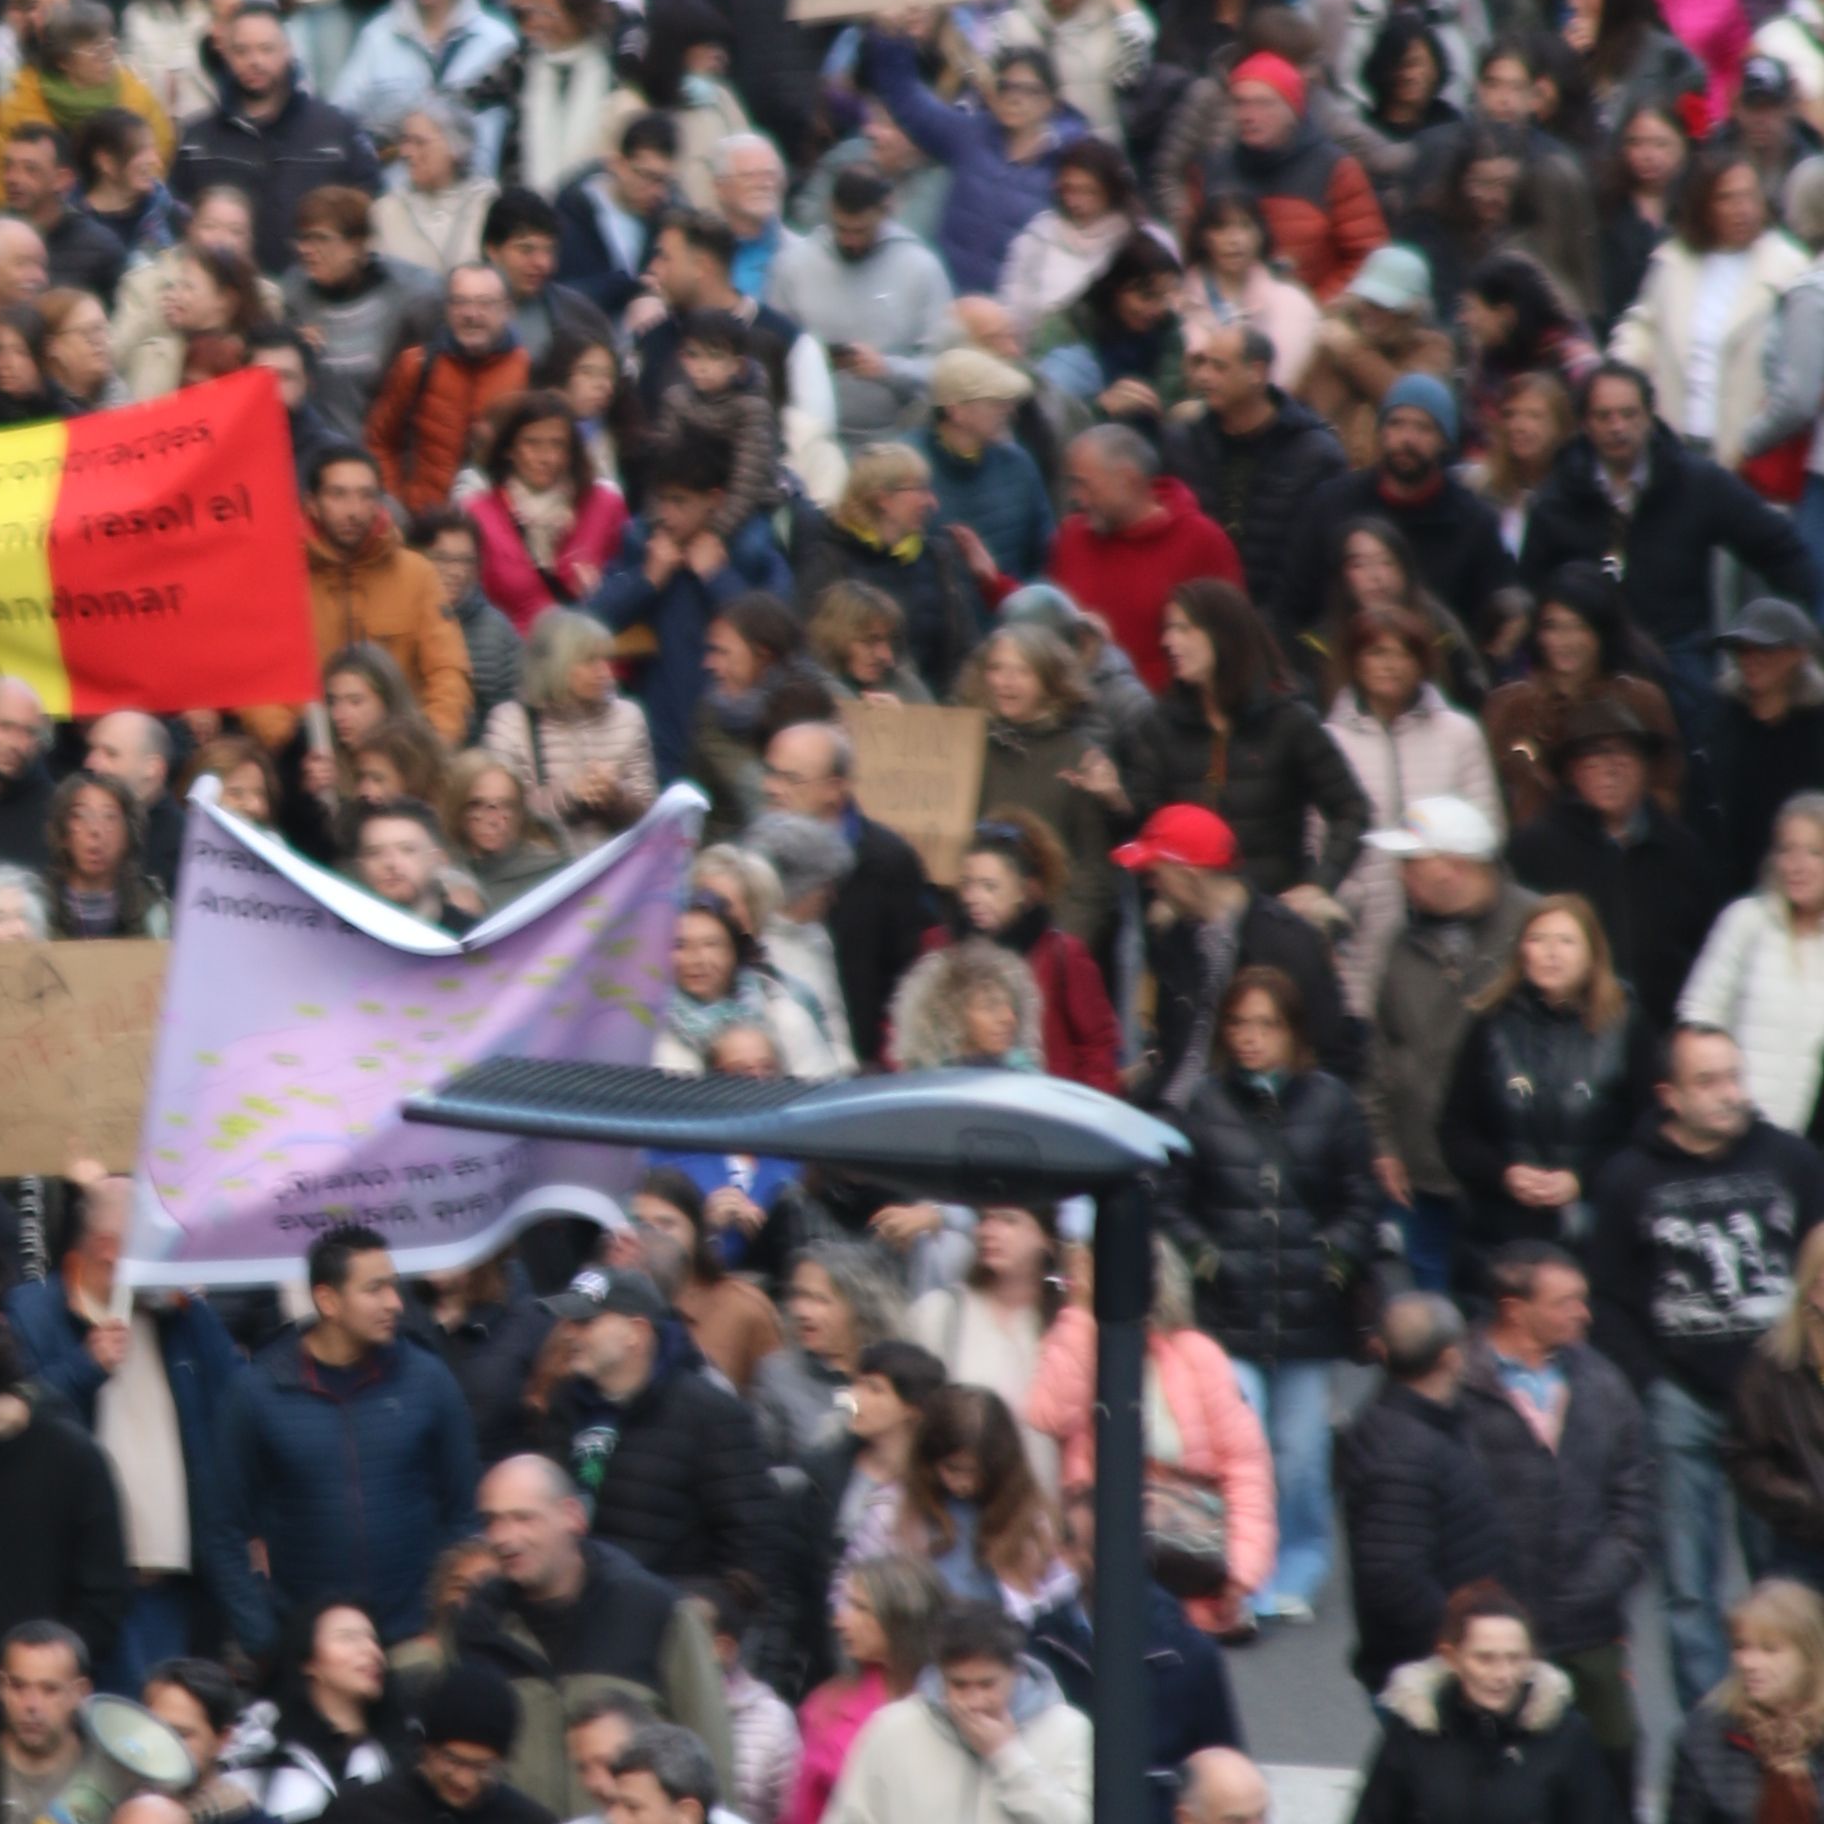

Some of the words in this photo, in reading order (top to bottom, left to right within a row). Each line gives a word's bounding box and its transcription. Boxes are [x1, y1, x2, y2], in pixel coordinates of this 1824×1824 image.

[77, 490, 197, 545] resol
[207, 481, 254, 524] el
[194, 885, 326, 930] Andorra
